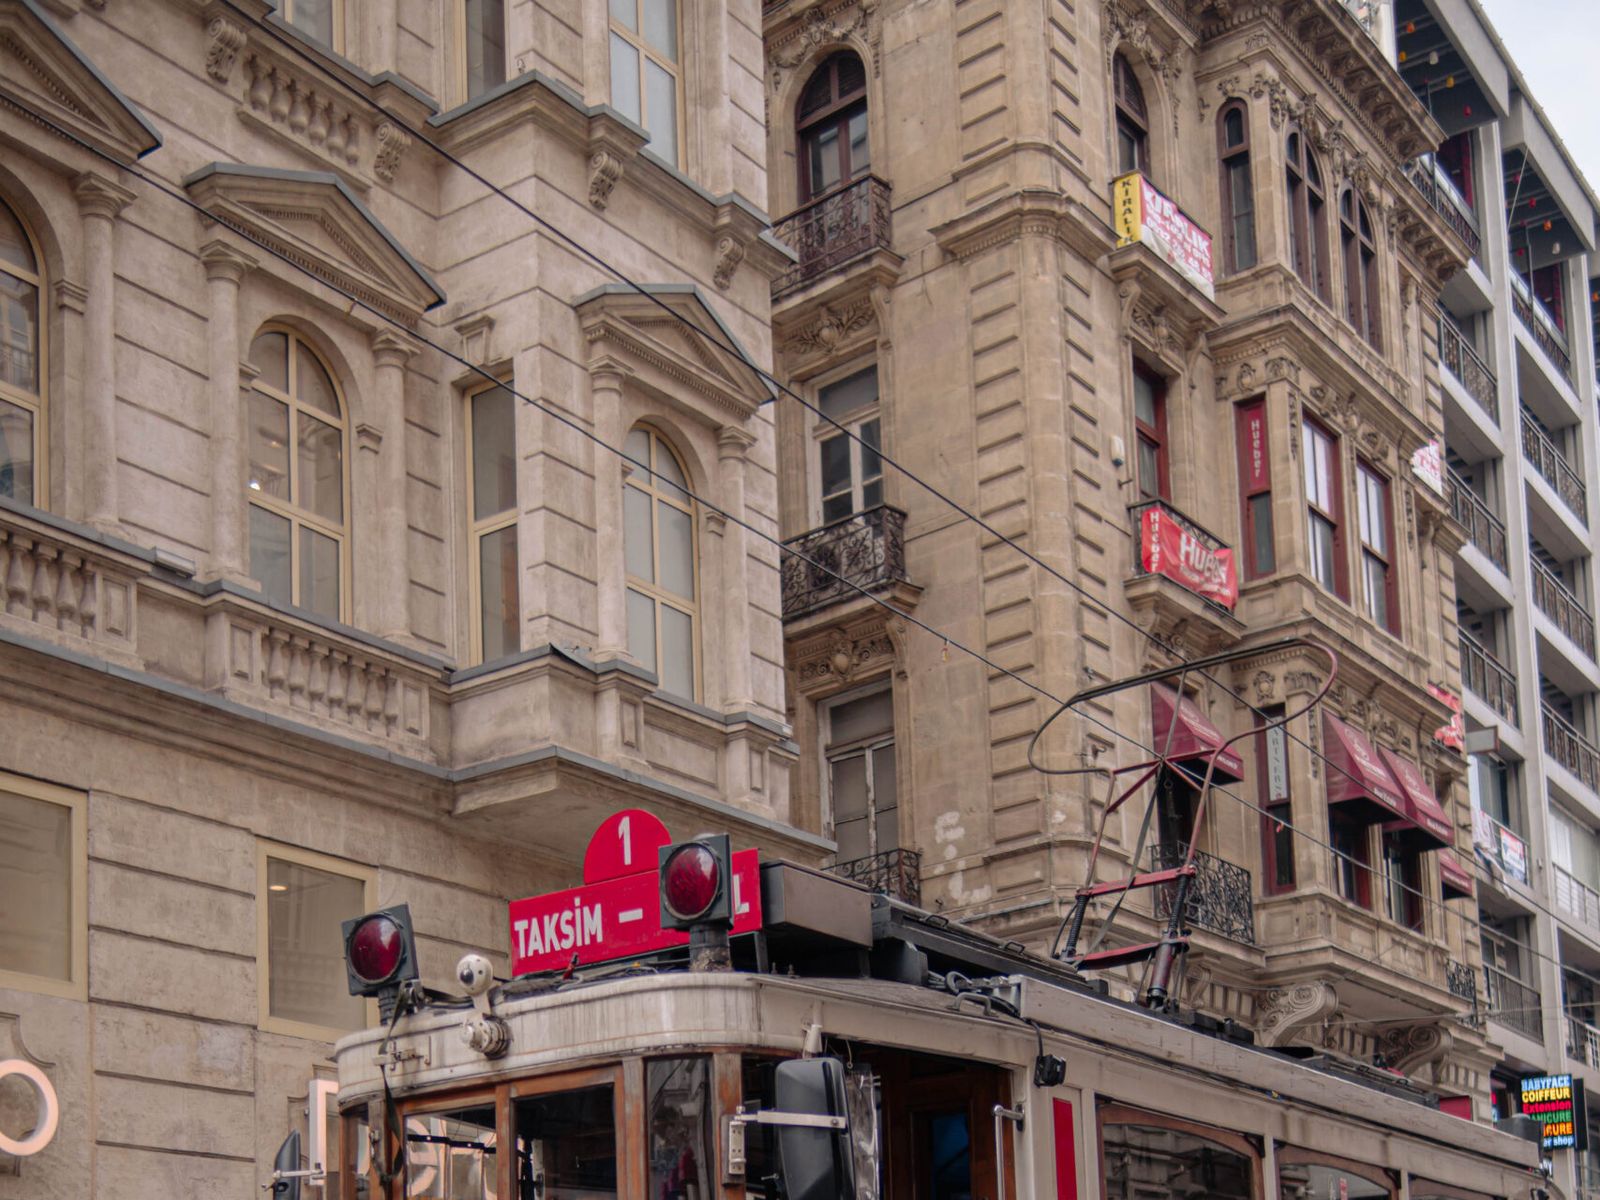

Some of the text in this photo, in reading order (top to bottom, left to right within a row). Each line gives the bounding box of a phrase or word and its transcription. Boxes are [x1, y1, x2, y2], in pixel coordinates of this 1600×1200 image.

[618, 815, 632, 866] 1
[513, 896, 603, 959] TAKSİM
[1521, 1076, 1570, 1091] BABYFACE
[1522, 1087, 1571, 1103] COIFFEUR
[1522, 1101, 1572, 1114] Extension
[1531, 1111, 1571, 1122] ANICURE
[1553, 1136, 1573, 1146] shop
